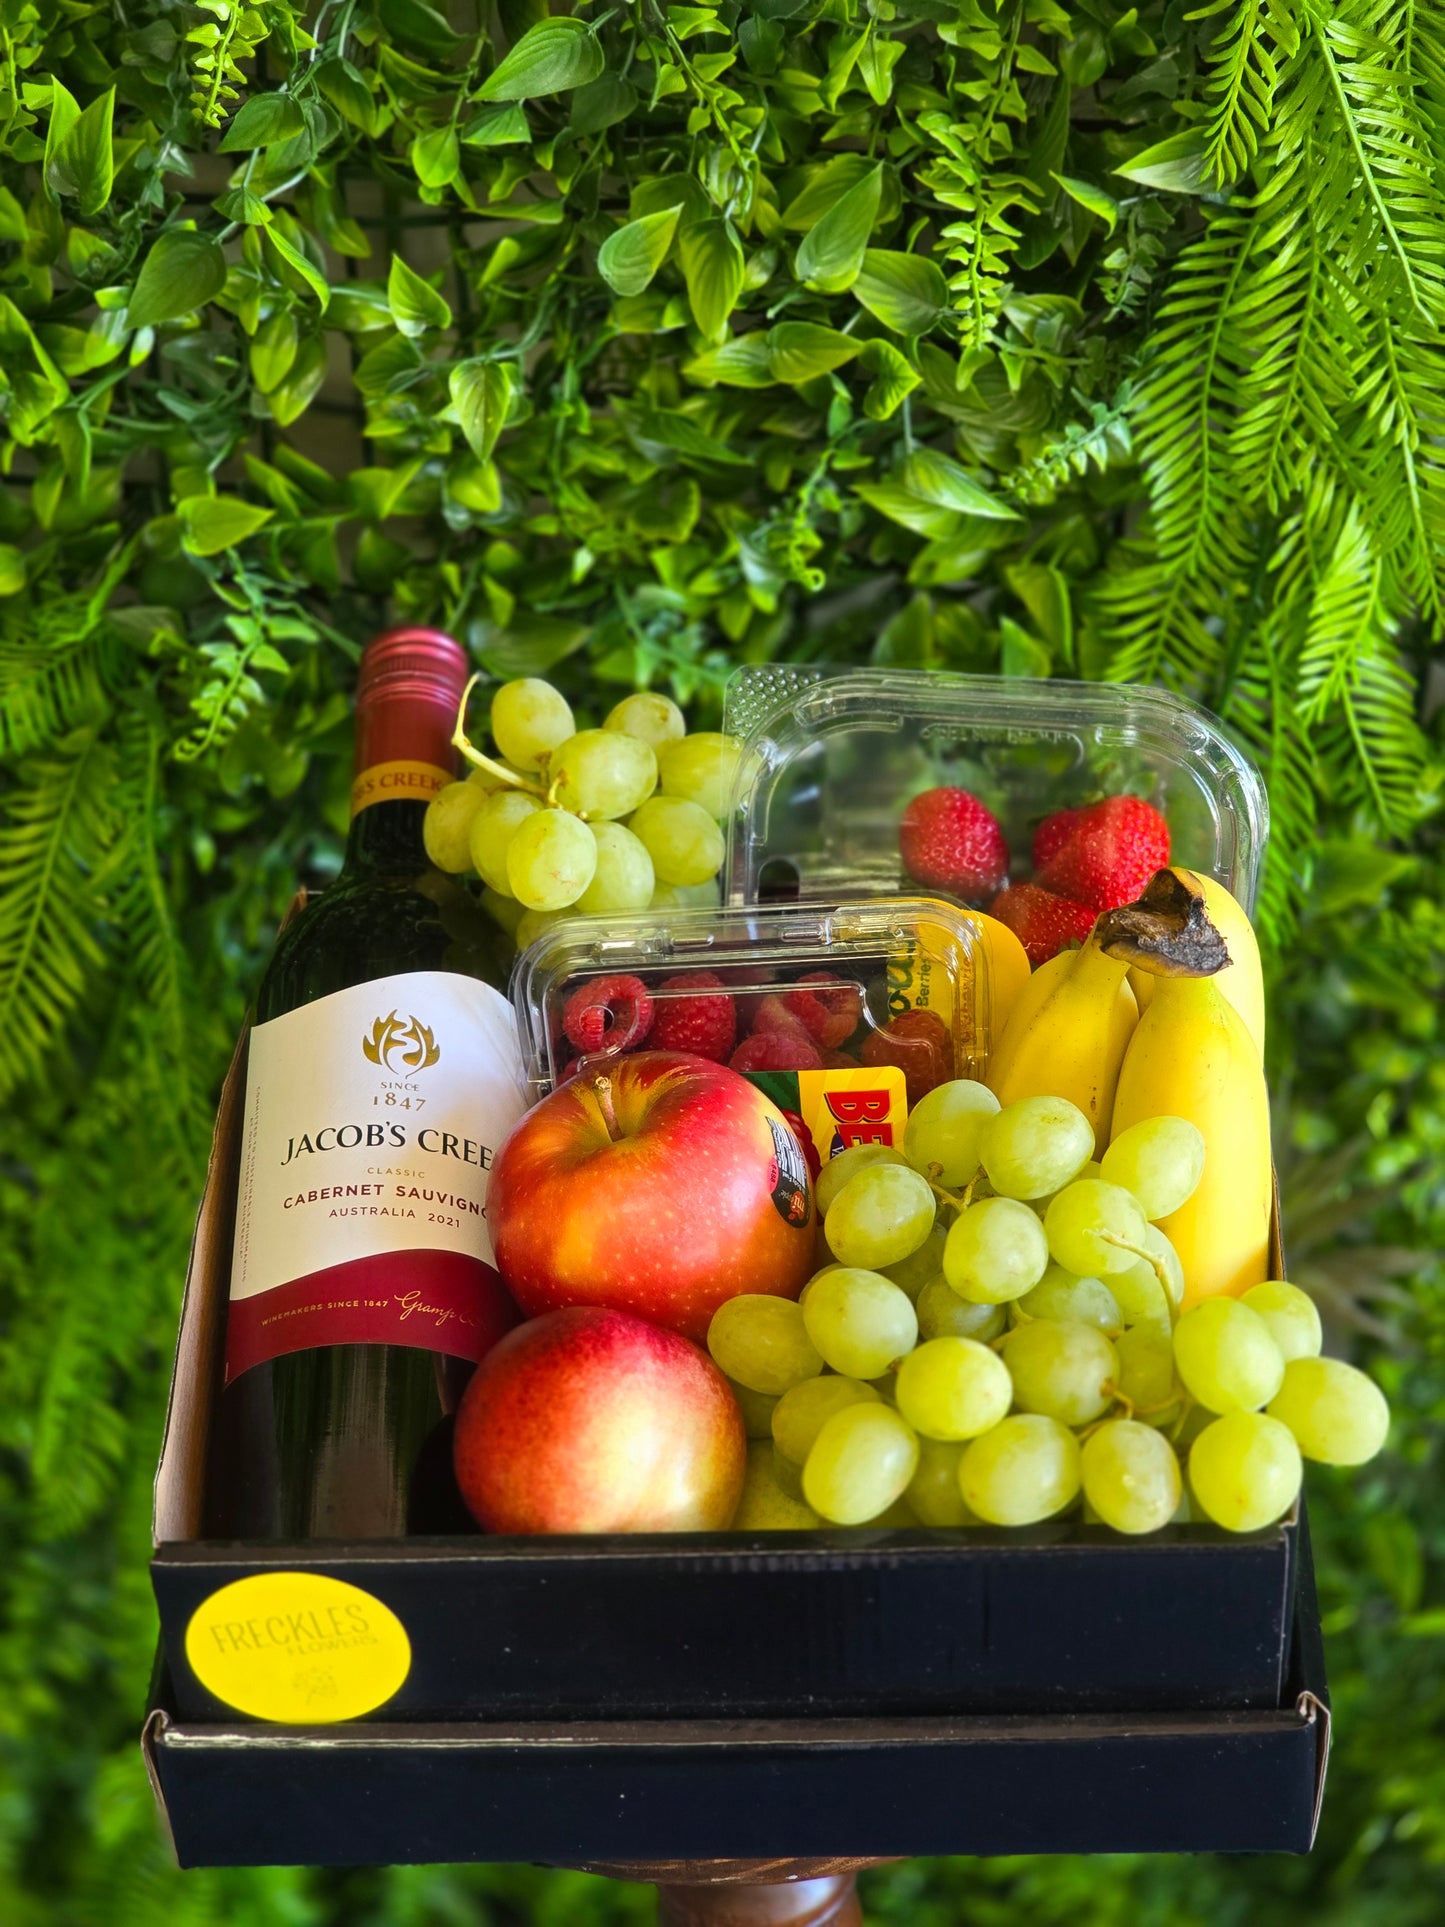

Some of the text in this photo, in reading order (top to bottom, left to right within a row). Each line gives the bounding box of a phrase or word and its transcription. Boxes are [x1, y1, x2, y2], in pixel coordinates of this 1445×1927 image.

[380, 1081, 420, 1092] SINCE
[372, 1093, 426, 1112] 1847
[280, 1121, 406, 1166] JACOB'S
[367, 1167, 426, 1179] CLASSIC
[283, 1184, 385, 1210] CABERNET
[328, 1206, 460, 1228] AUSTRALIA 2021
[260, 1303, 323, 1327] WINEMAKERS
[327, 1299, 360, 1309] SINCE
[363, 1299, 390, 1308] 1847
[209, 1603, 370, 1654] FRECKLES
